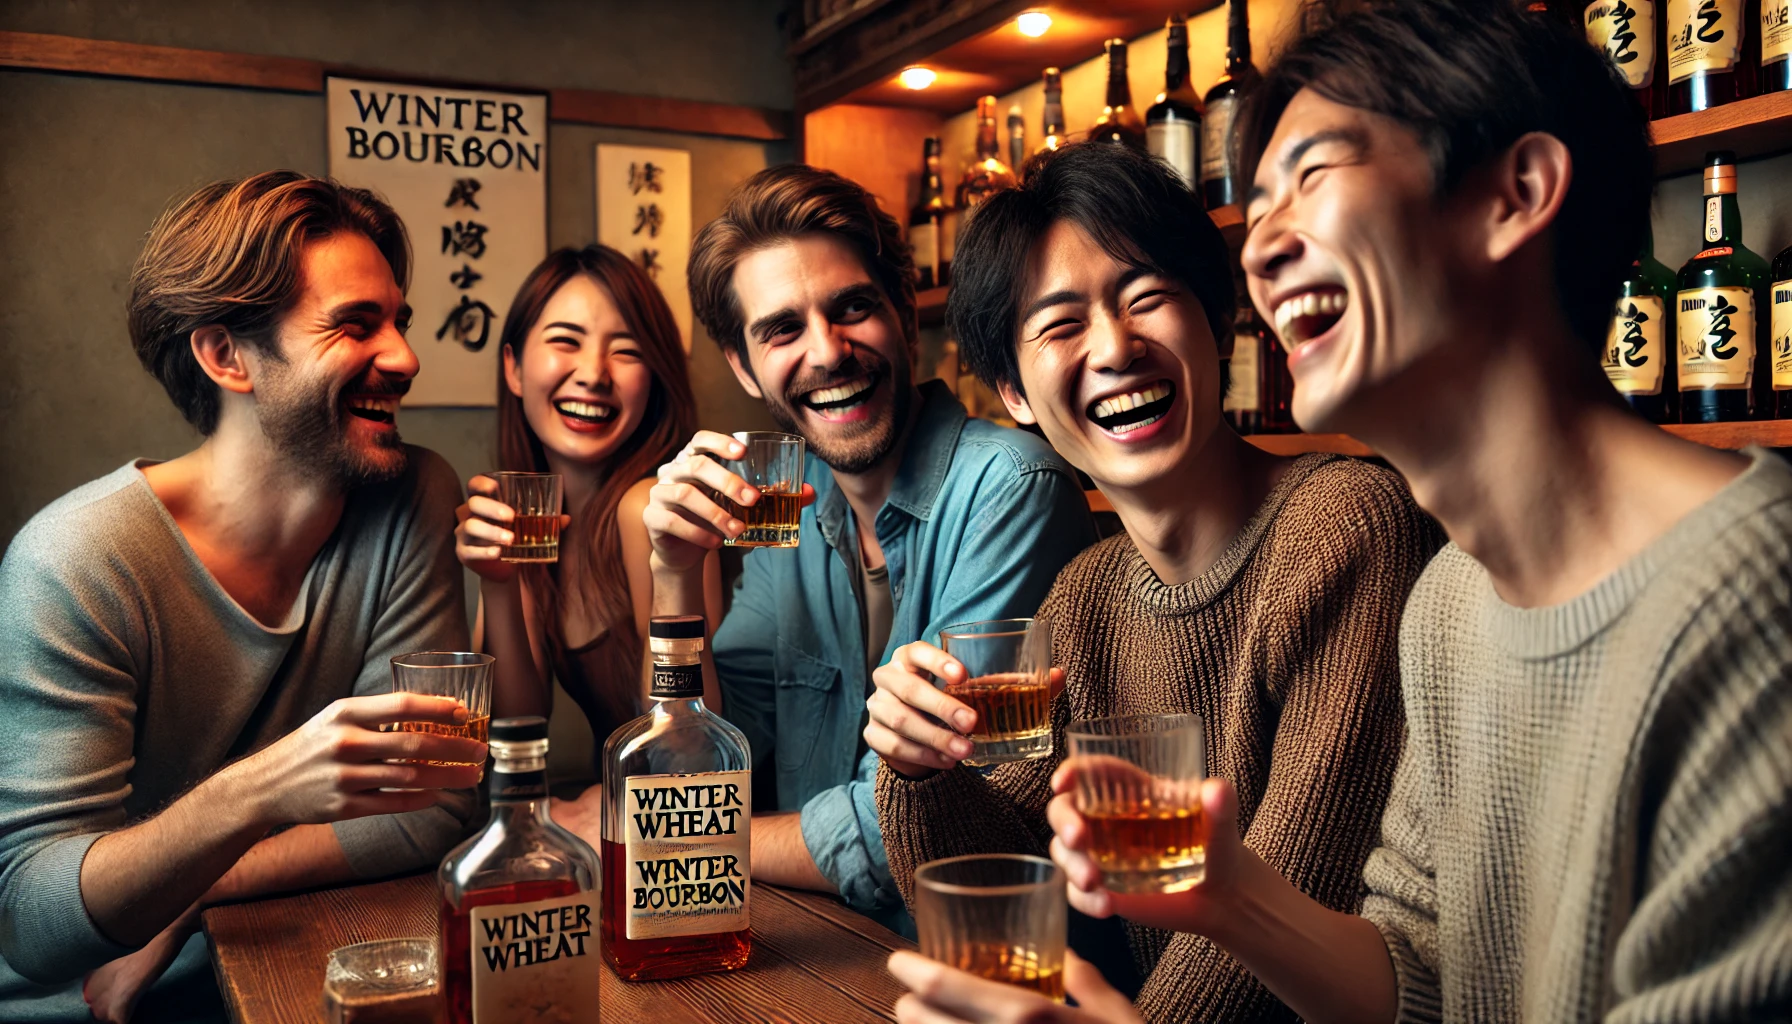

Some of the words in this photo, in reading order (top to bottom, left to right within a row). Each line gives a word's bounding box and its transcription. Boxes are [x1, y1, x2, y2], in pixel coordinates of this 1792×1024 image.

[350, 89, 529, 136] WINTER
[345, 126, 542, 172] BOURBON
[631, 783, 743, 810] WINTER
[633, 808, 742, 840] WHEAT
[635, 855, 742, 886] WINTER
[480, 904, 592, 942] WINTER
[482, 931, 591, 972] WHEAT
